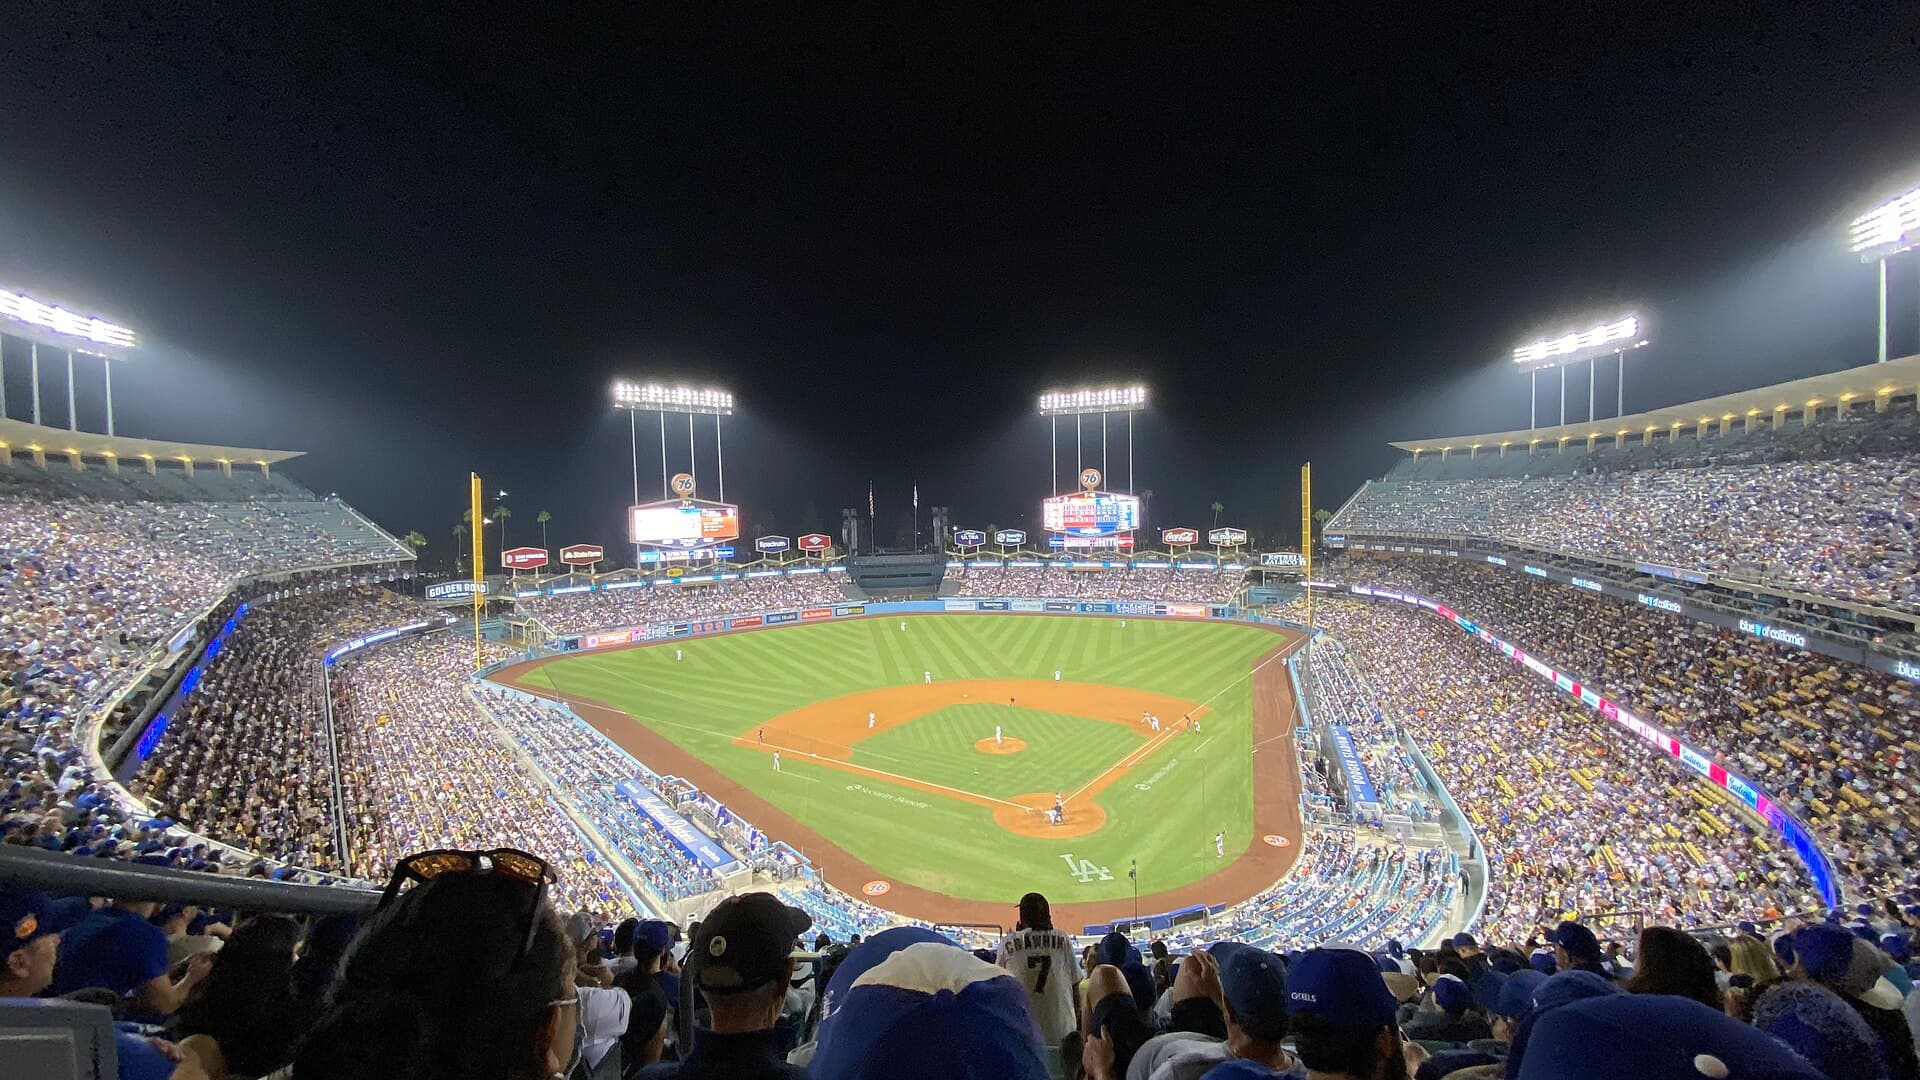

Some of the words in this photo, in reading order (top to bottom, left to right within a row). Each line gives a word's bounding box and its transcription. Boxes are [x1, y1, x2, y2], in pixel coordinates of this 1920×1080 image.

[678, 479, 692, 490] 76
[1085, 473, 1097, 483] 76
[429, 583, 463, 598] GOLDEN
[464, 583, 486, 593] ROAD
[1739, 620, 1755, 633] blue
[1761, 625, 1770, 637] of
[1770, 629, 1806, 647] california
[1898, 661, 1920, 680] blue
[1059, 853, 1115, 883] LA
[1027, 955, 1052, 994] 7
